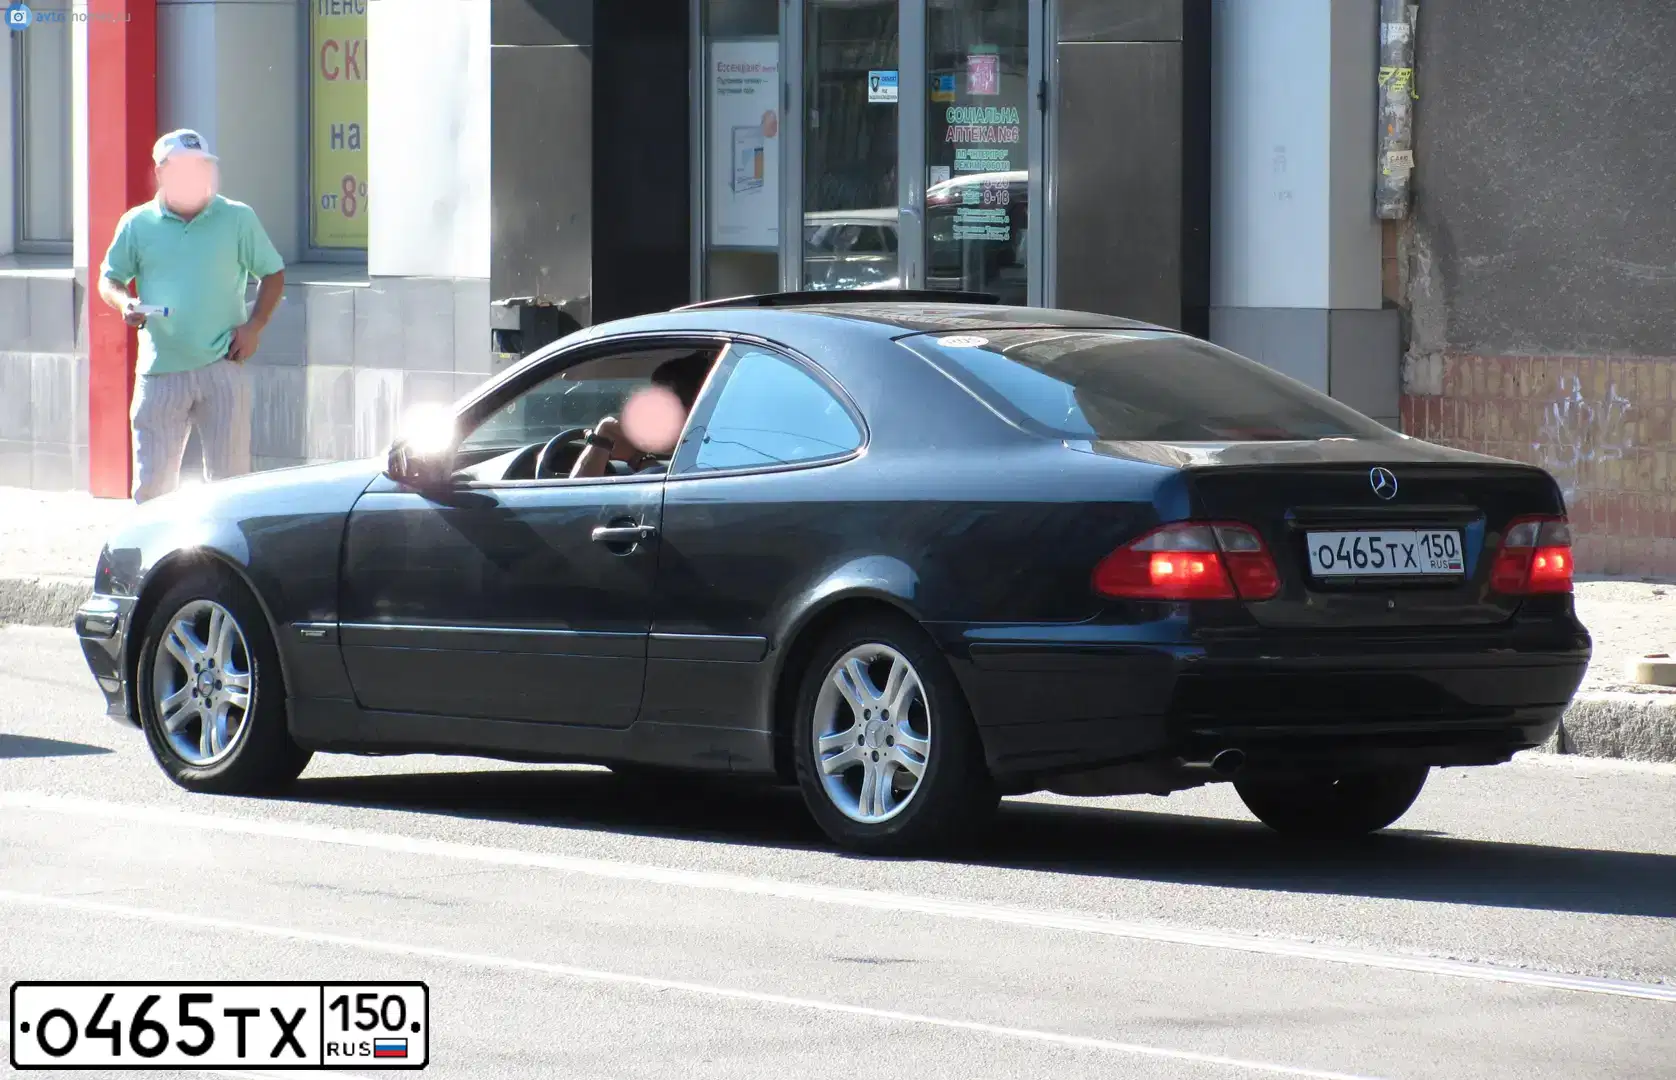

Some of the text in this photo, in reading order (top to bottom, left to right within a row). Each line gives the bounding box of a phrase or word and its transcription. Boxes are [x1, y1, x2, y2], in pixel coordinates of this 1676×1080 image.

[321, 39, 368, 81] СК
[945, 106, 1020, 125] СОЦІАЛЬНА
[330, 122, 361, 150] на
[945, 126, 1020, 143] АПТЕКА №6
[981, 160, 1011, 171] РОБОТИ
[983, 190, 1010, 205] 9-18
[1318, 534, 1456, 570] О465ТХ 150
[1430, 561, 1449, 569] RUS
